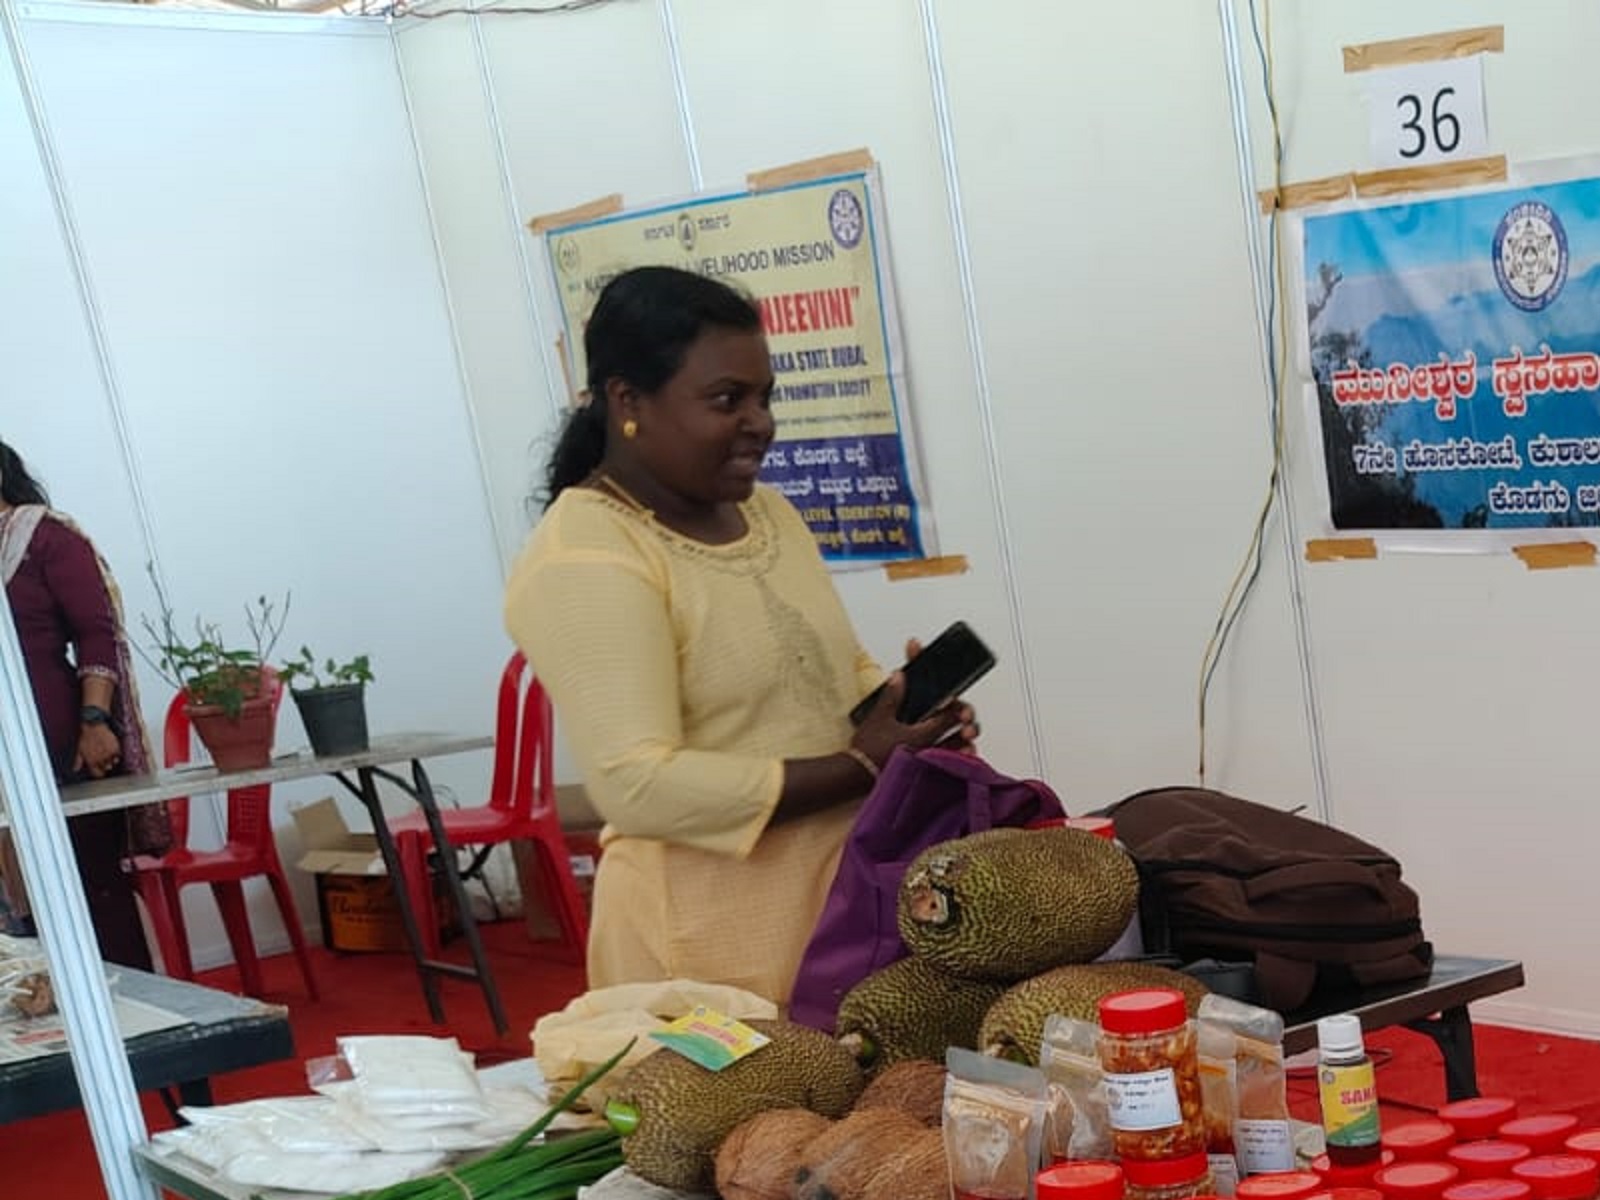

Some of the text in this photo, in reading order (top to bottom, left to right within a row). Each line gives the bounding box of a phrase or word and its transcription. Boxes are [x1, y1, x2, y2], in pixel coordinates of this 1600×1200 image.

[1397, 87, 1460, 158] 36
[773, 240, 835, 267] MISSION
[1491, 482, 1569, 514] ಕೊಡಗು
